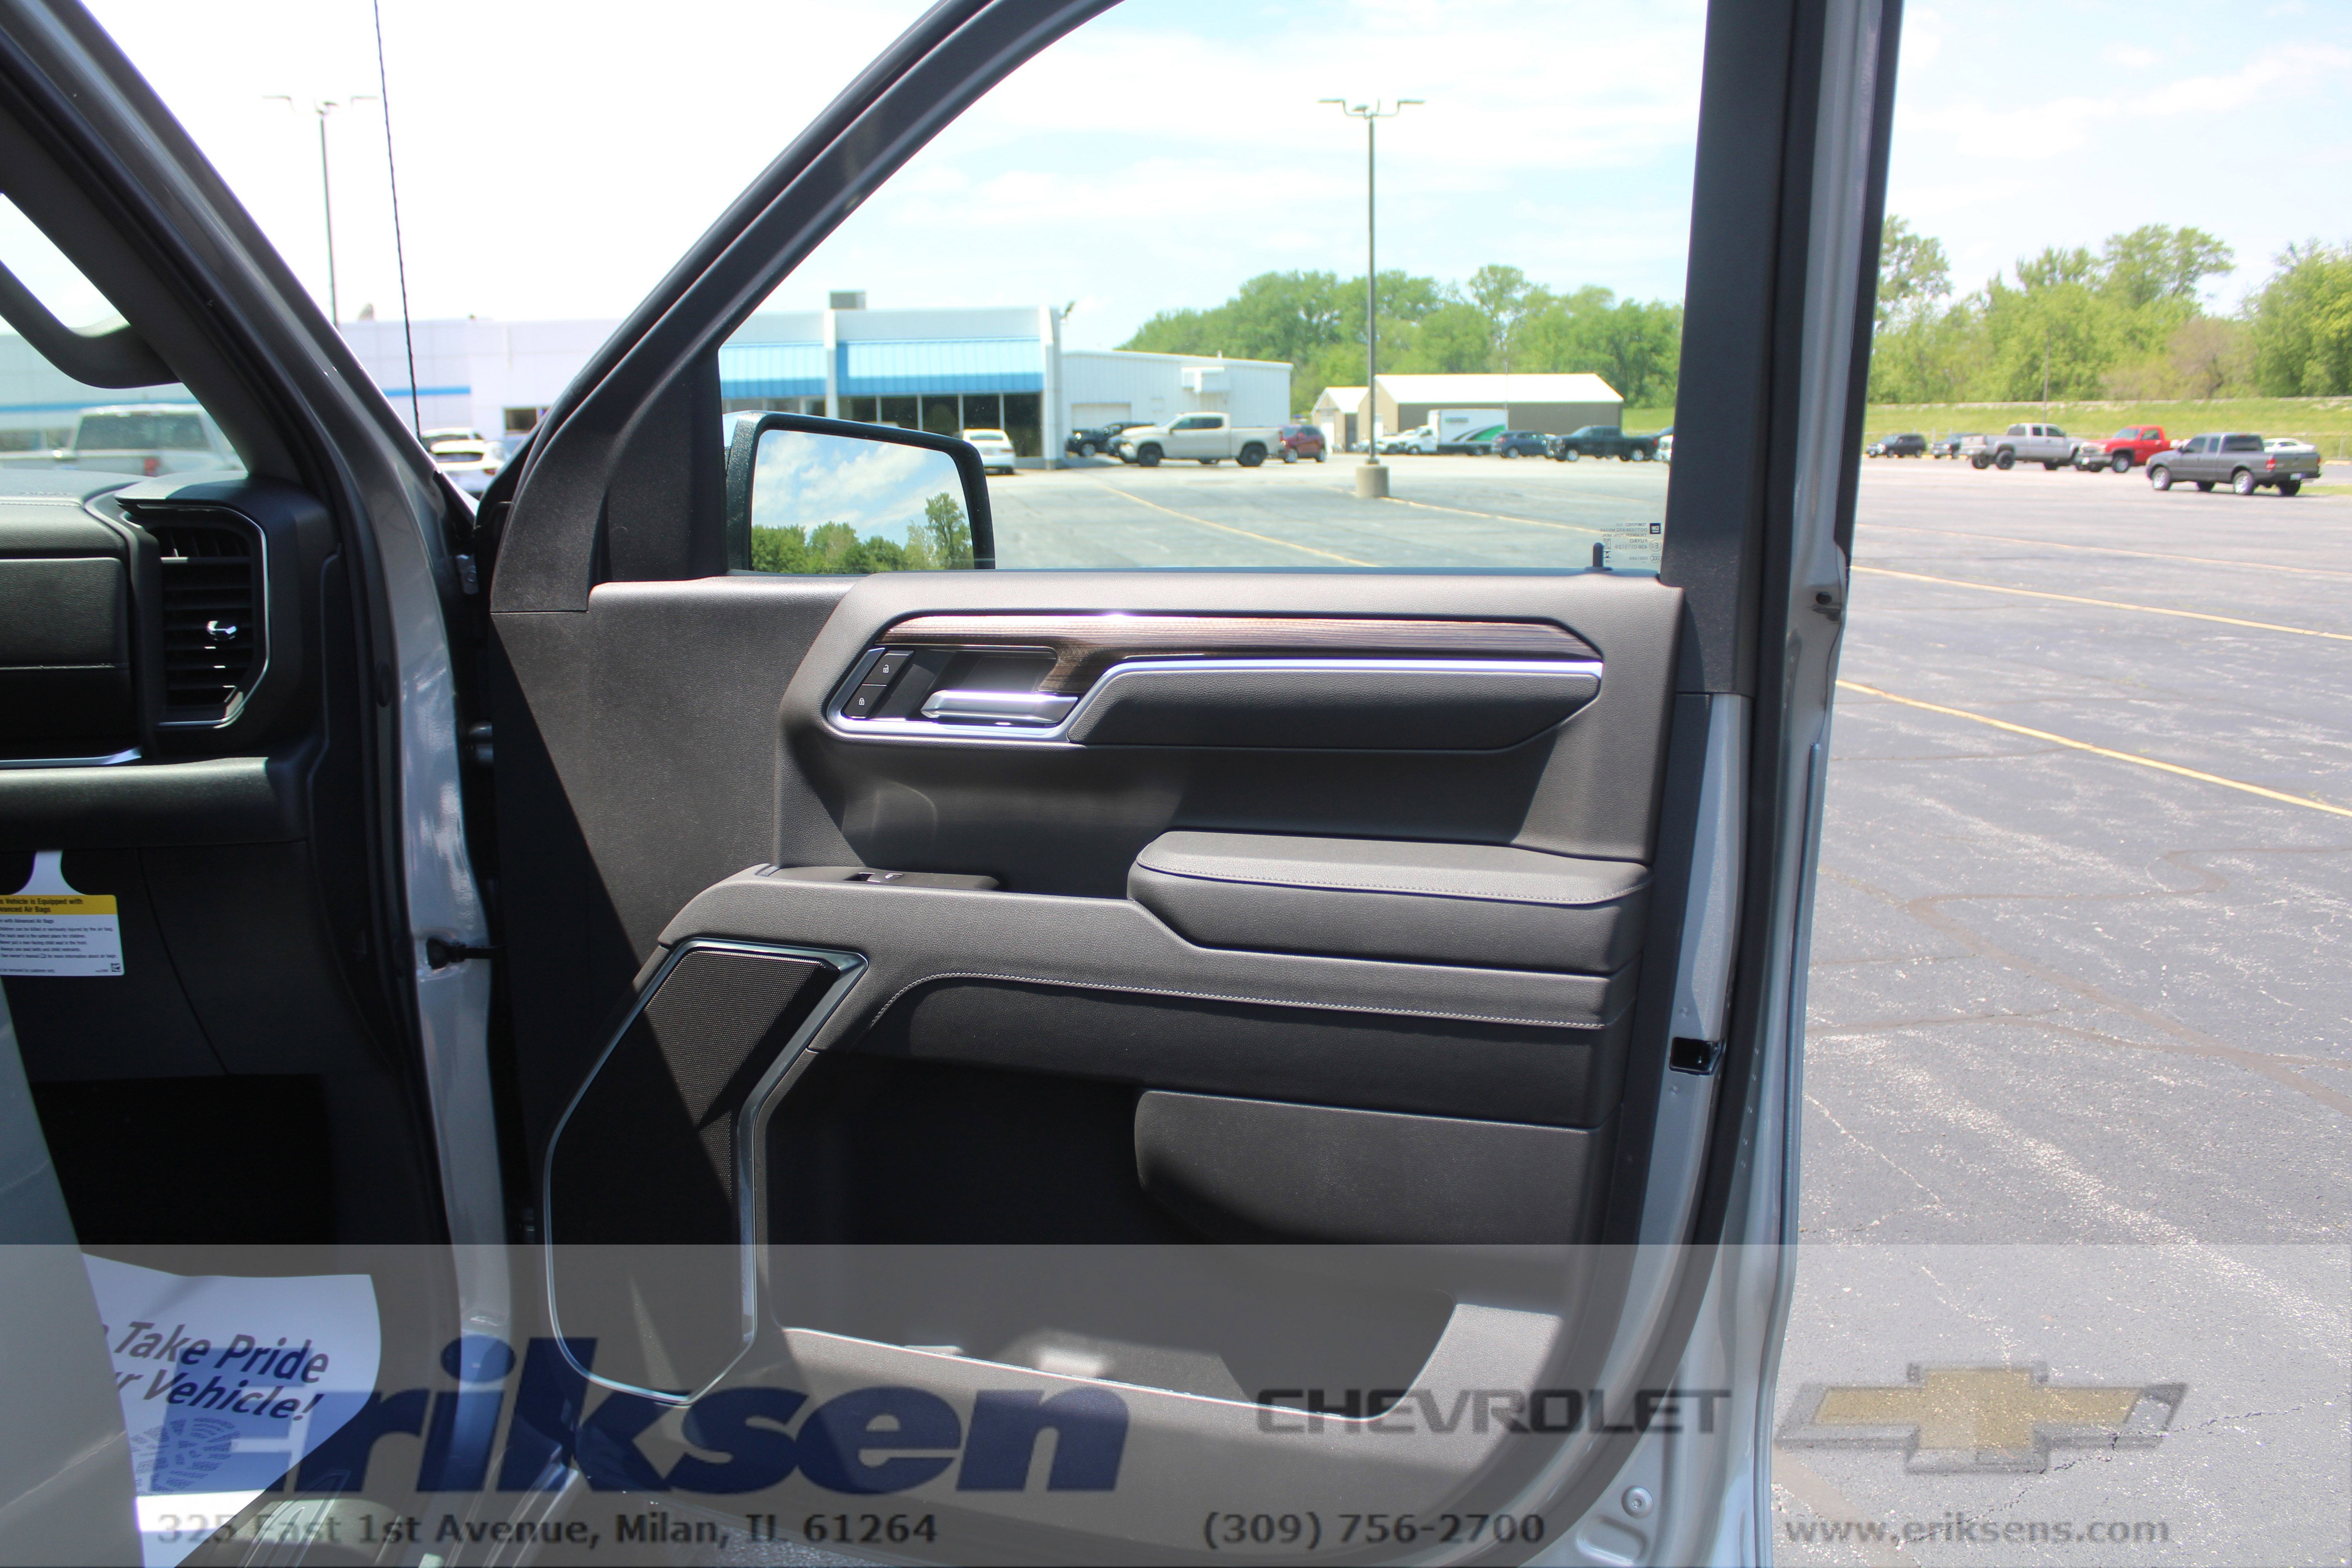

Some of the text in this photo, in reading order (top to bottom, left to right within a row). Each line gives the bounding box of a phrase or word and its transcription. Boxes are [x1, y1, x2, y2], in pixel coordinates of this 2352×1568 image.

[114, 1321, 329, 1383] Take Pride
[143, 1368, 325, 1421] Vehicle!
